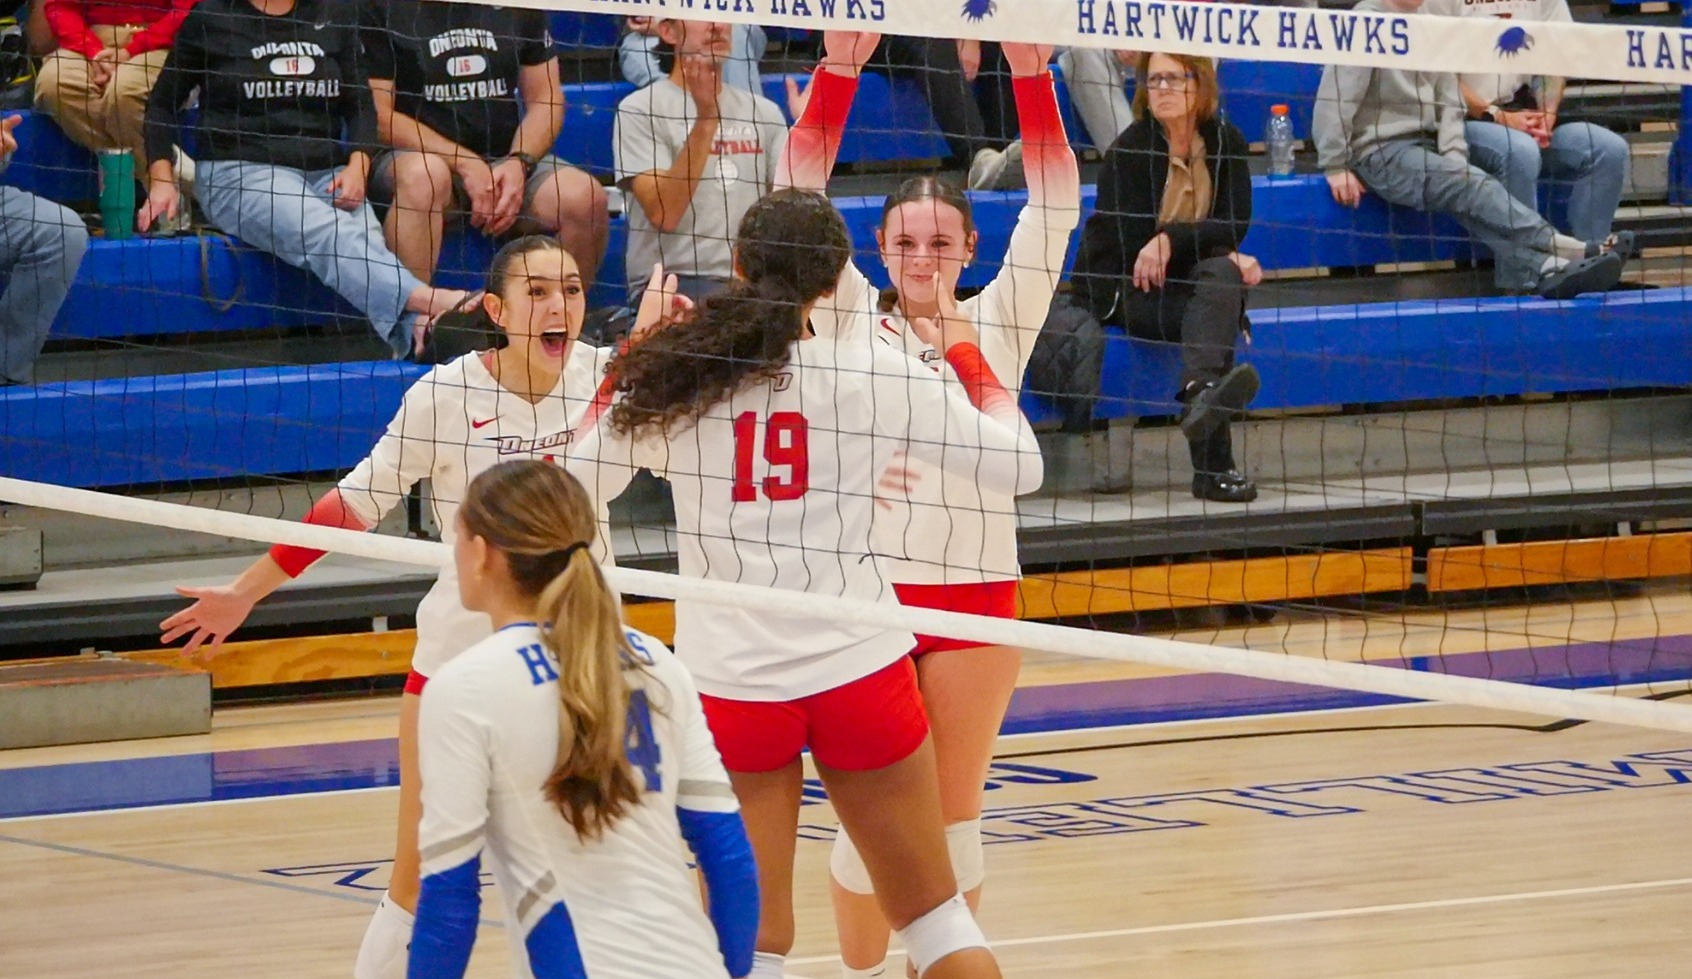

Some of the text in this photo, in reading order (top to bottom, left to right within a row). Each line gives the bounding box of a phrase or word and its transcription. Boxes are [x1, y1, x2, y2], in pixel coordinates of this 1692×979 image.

[1077, 0, 1410, 56] HARTWICK HAWKS
[243, 79, 340, 99] VOLLEYBALL
[424, 78, 508, 102] VOLLEYBALL
[731, 411, 809, 502] 19
